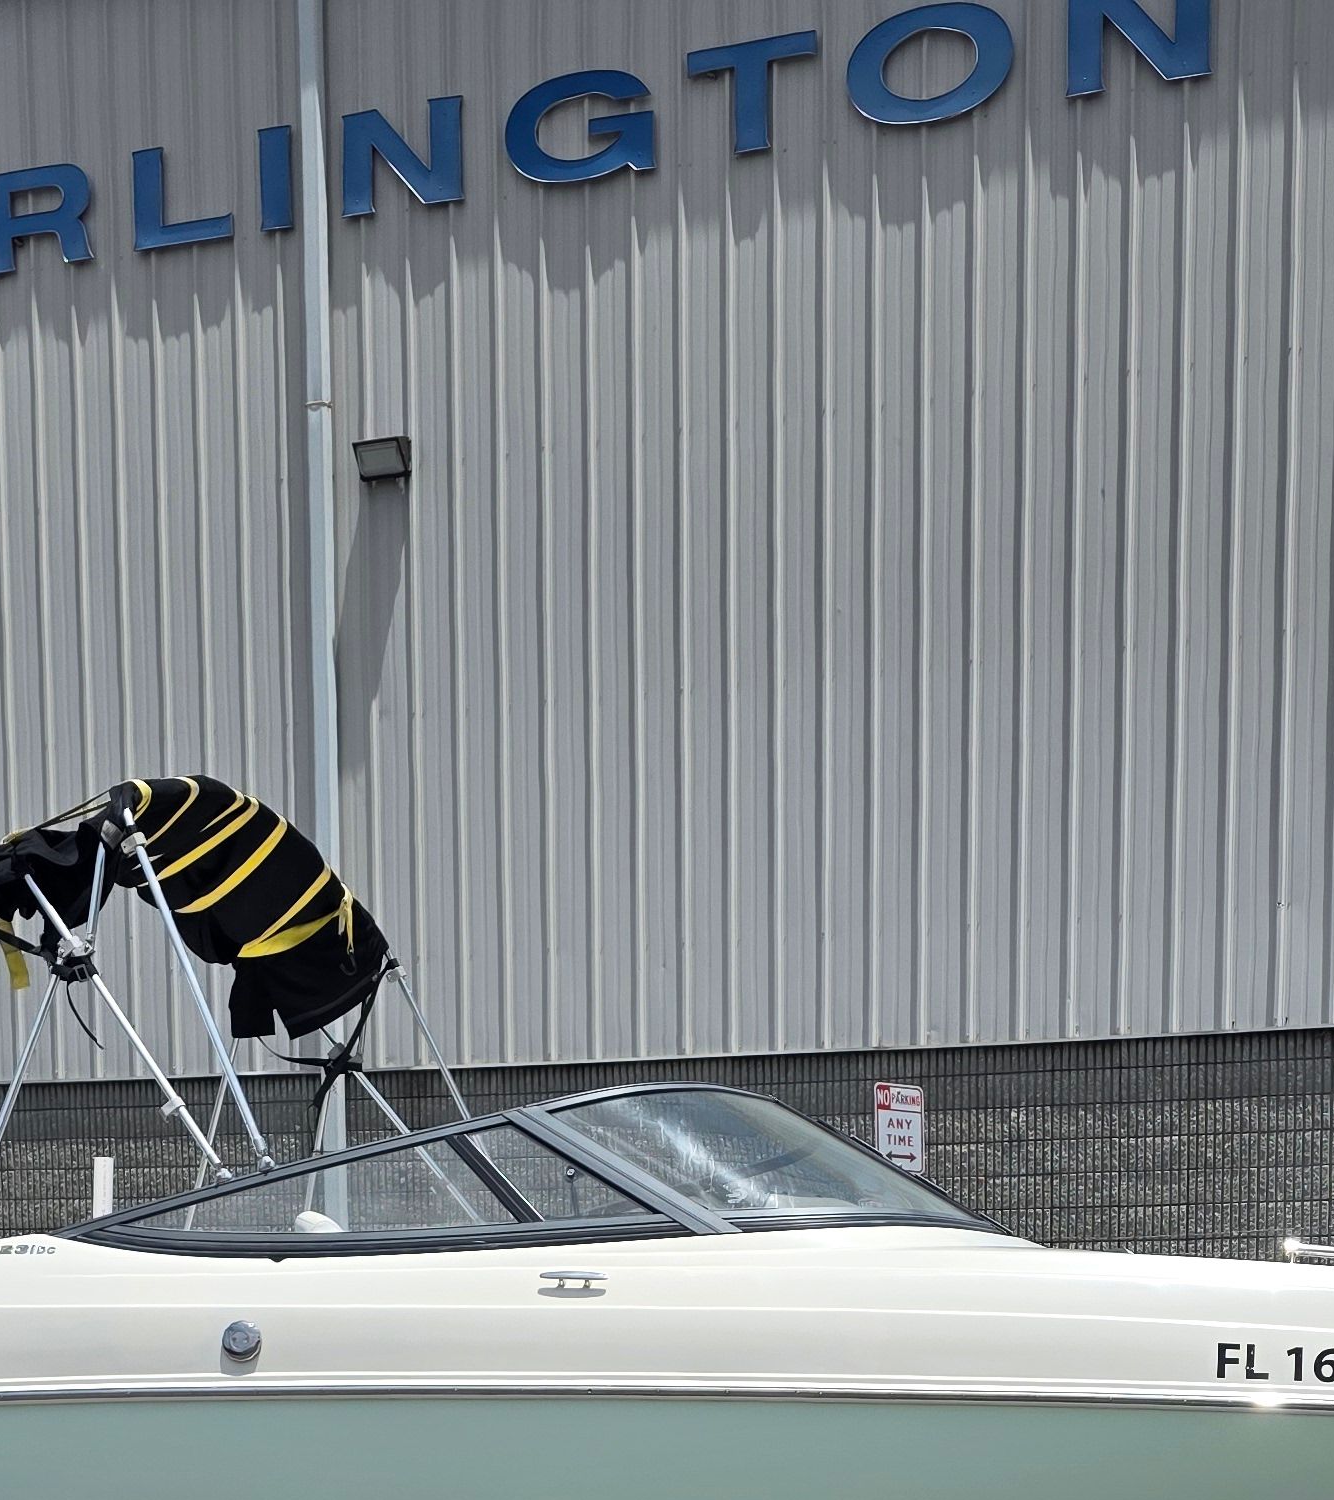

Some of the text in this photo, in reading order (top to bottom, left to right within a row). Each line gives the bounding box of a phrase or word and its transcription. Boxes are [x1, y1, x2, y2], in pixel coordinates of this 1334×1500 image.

[876, 1088, 921, 1107] NO PARKING
[887, 1117, 913, 1130] ANY
[886, 1134, 914, 1147] TIME
[1216, 1342, 1269, 1380] FL
